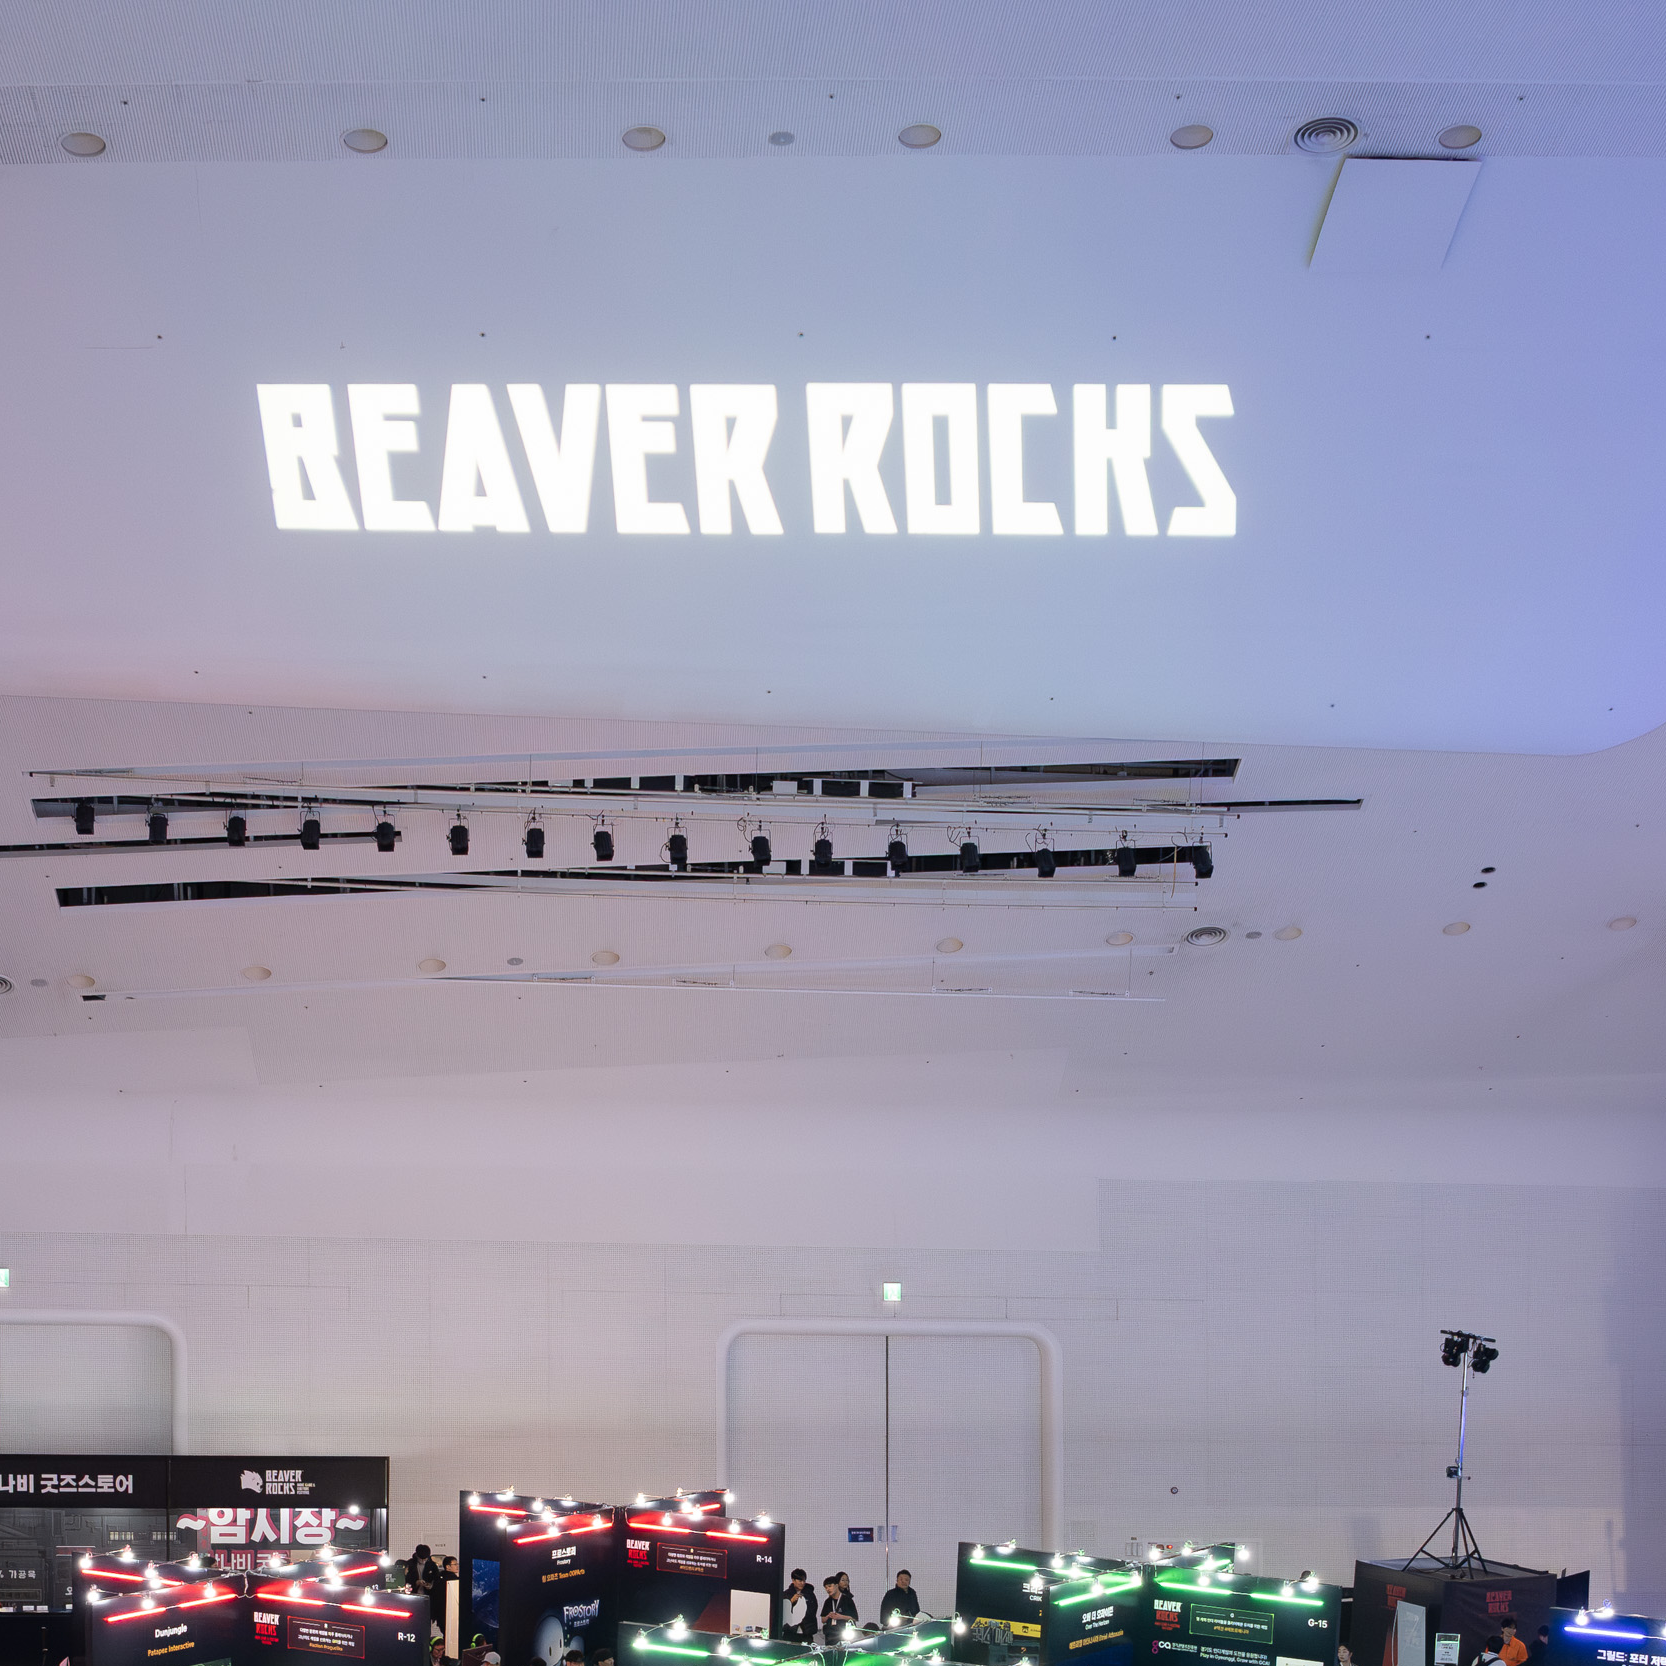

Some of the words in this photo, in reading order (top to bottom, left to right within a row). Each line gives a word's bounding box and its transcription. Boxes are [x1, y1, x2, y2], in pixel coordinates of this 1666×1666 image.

[256, 383, 784, 535] BEAVER
[805, 382, 1237, 537] ROCKS
[40, 1474, 134, 1494] 굿즈스토어
[756, 1554, 772, 1563] R-14
[1307, 1618, 1328, 1628] G-15
[398, 1632, 415, 1642] R-12
